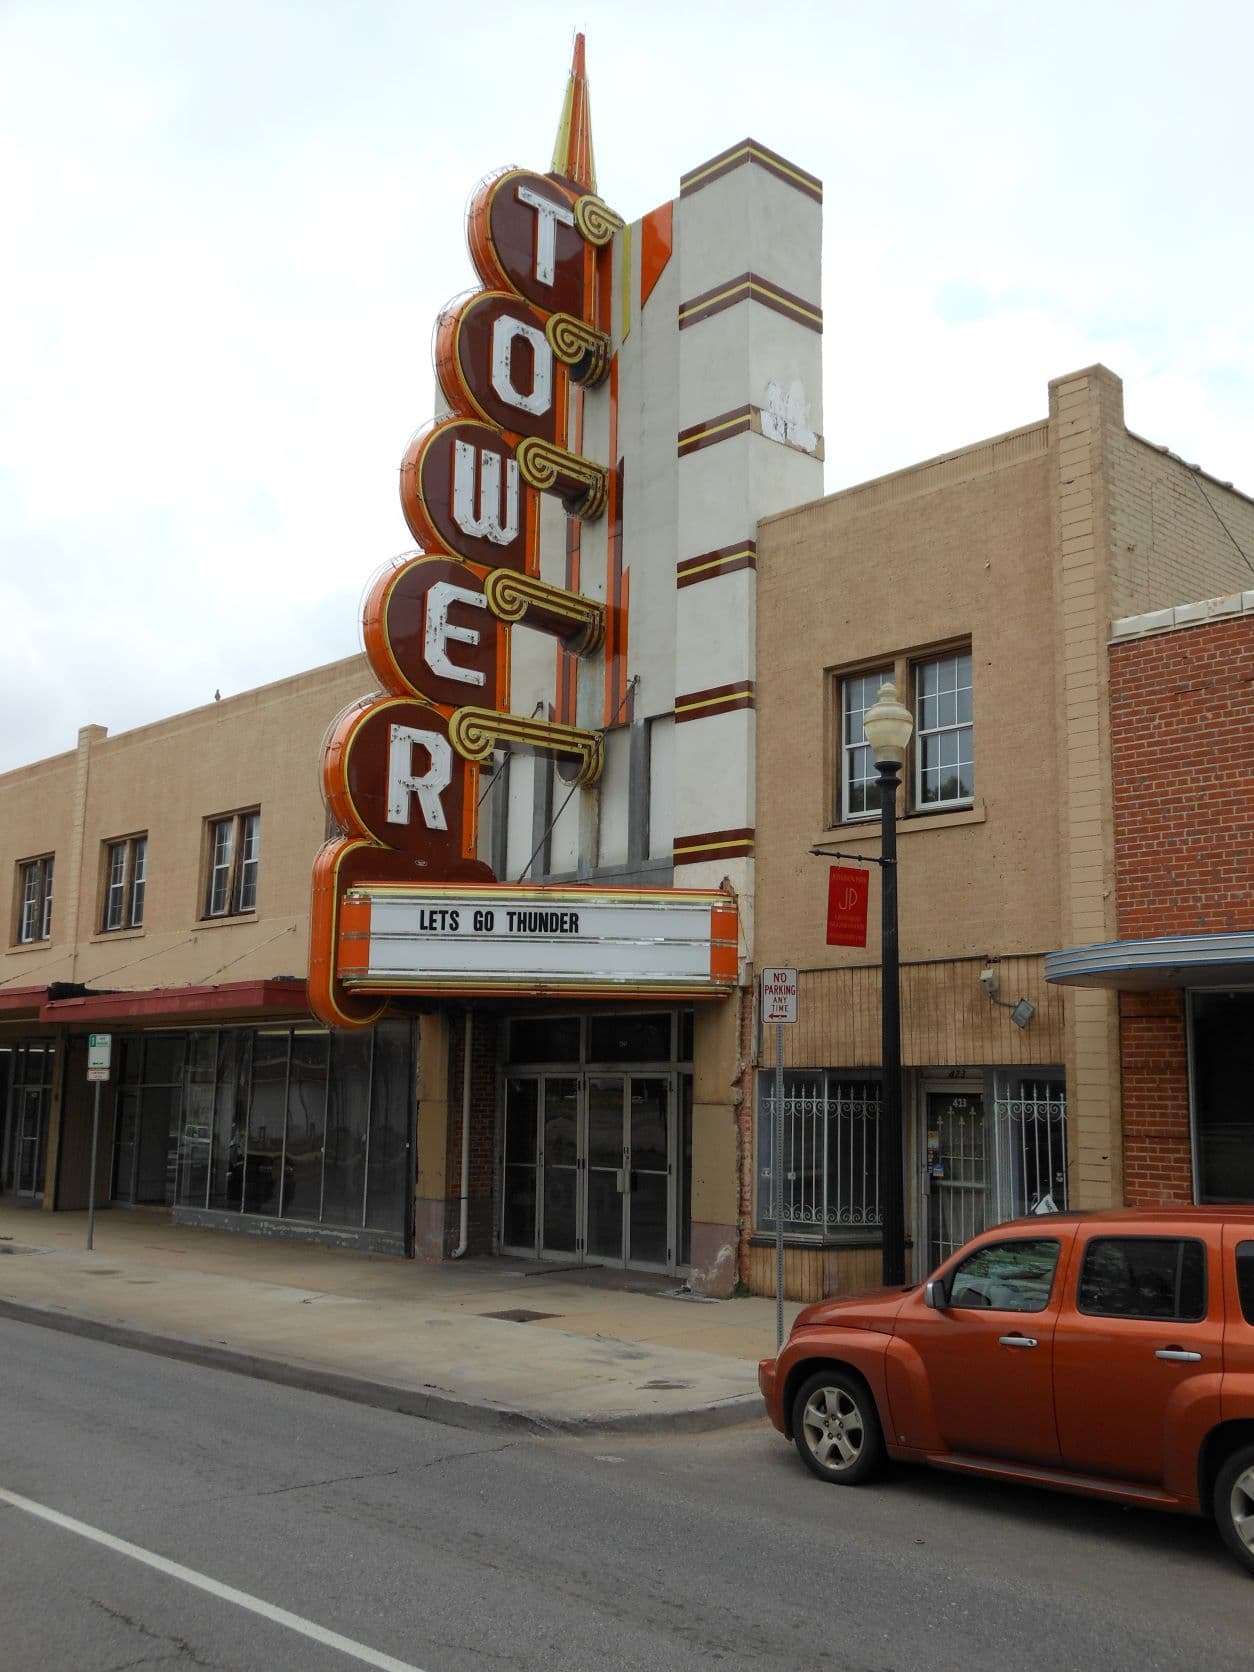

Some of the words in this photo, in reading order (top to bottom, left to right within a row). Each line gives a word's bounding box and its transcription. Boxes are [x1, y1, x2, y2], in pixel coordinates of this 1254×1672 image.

[385, 185, 575, 832] TOWER
[419, 909, 460, 931] LETS
[473, 910, 495, 932] GO
[506, 911, 579, 933] THUNDER
[773, 972, 787, 983] NO
[764, 984, 796, 996] PARKING
[773, 996, 787, 1004] ANY
[770, 1004, 788, 1012] TIME
